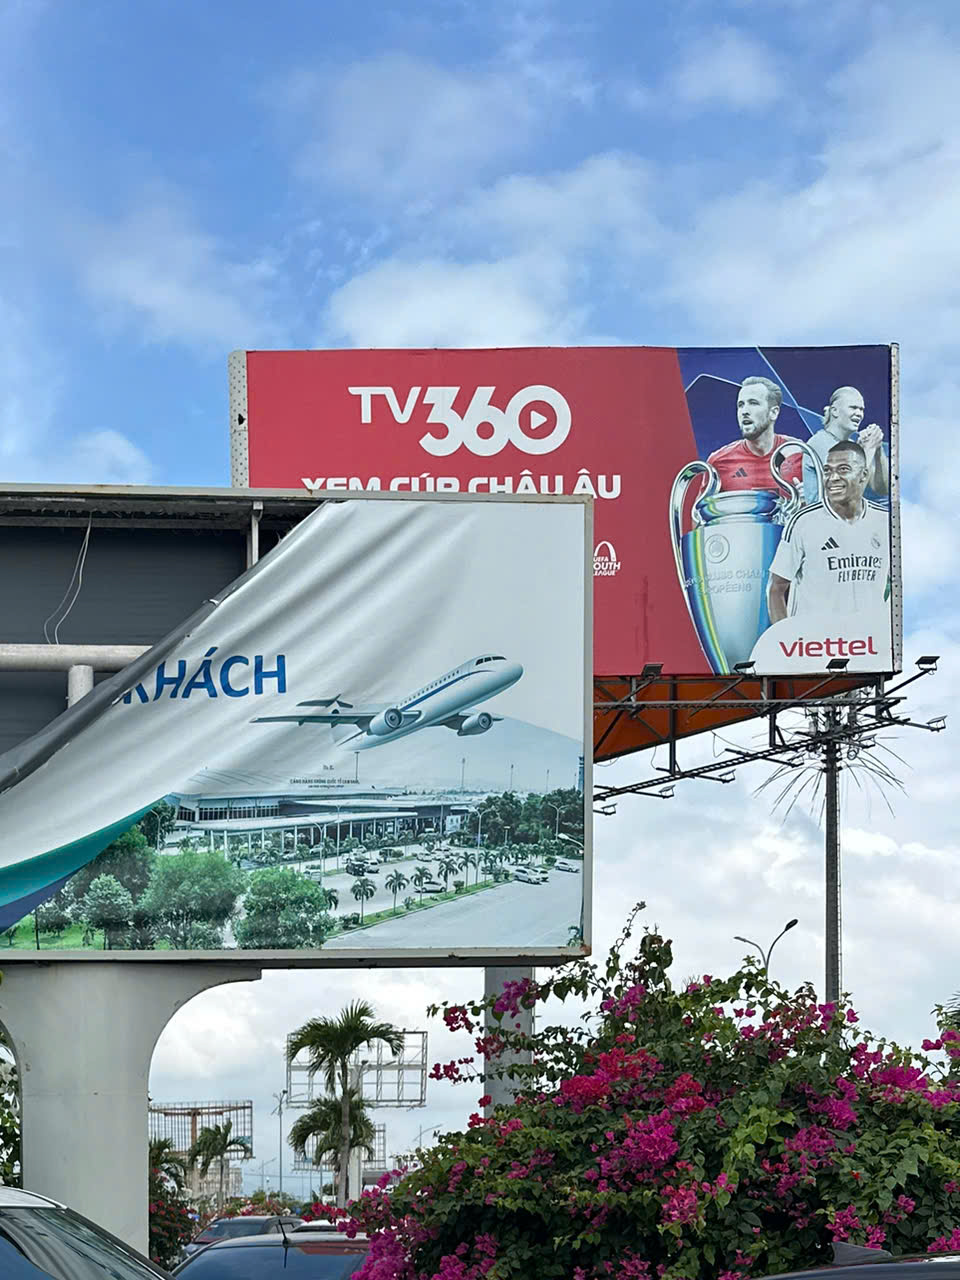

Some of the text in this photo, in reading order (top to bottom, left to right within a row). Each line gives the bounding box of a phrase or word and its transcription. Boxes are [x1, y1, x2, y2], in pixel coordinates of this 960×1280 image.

[348, 384, 572, 456] TV360
[573, 468, 621, 499] ÂU
[593, 562, 621, 570] OUTH
[779, 636, 878, 657] viettel
